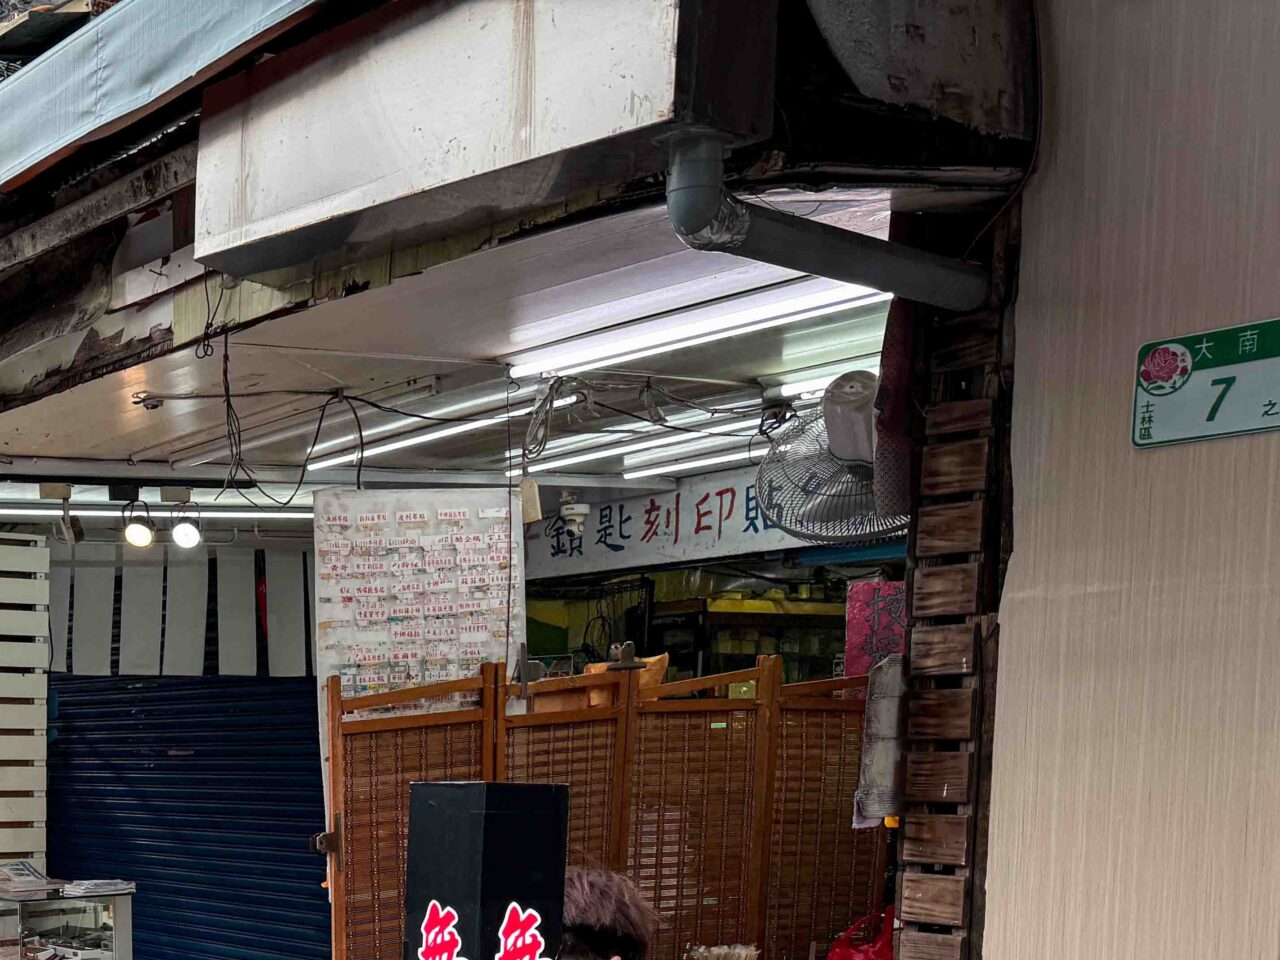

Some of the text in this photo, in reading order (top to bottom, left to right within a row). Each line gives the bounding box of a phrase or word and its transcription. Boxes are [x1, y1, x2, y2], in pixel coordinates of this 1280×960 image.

[1194, 329, 1259, 362] 大南
[1205, 375, 1237, 422] 7
[1140, 401, 1155, 440] 士林區
